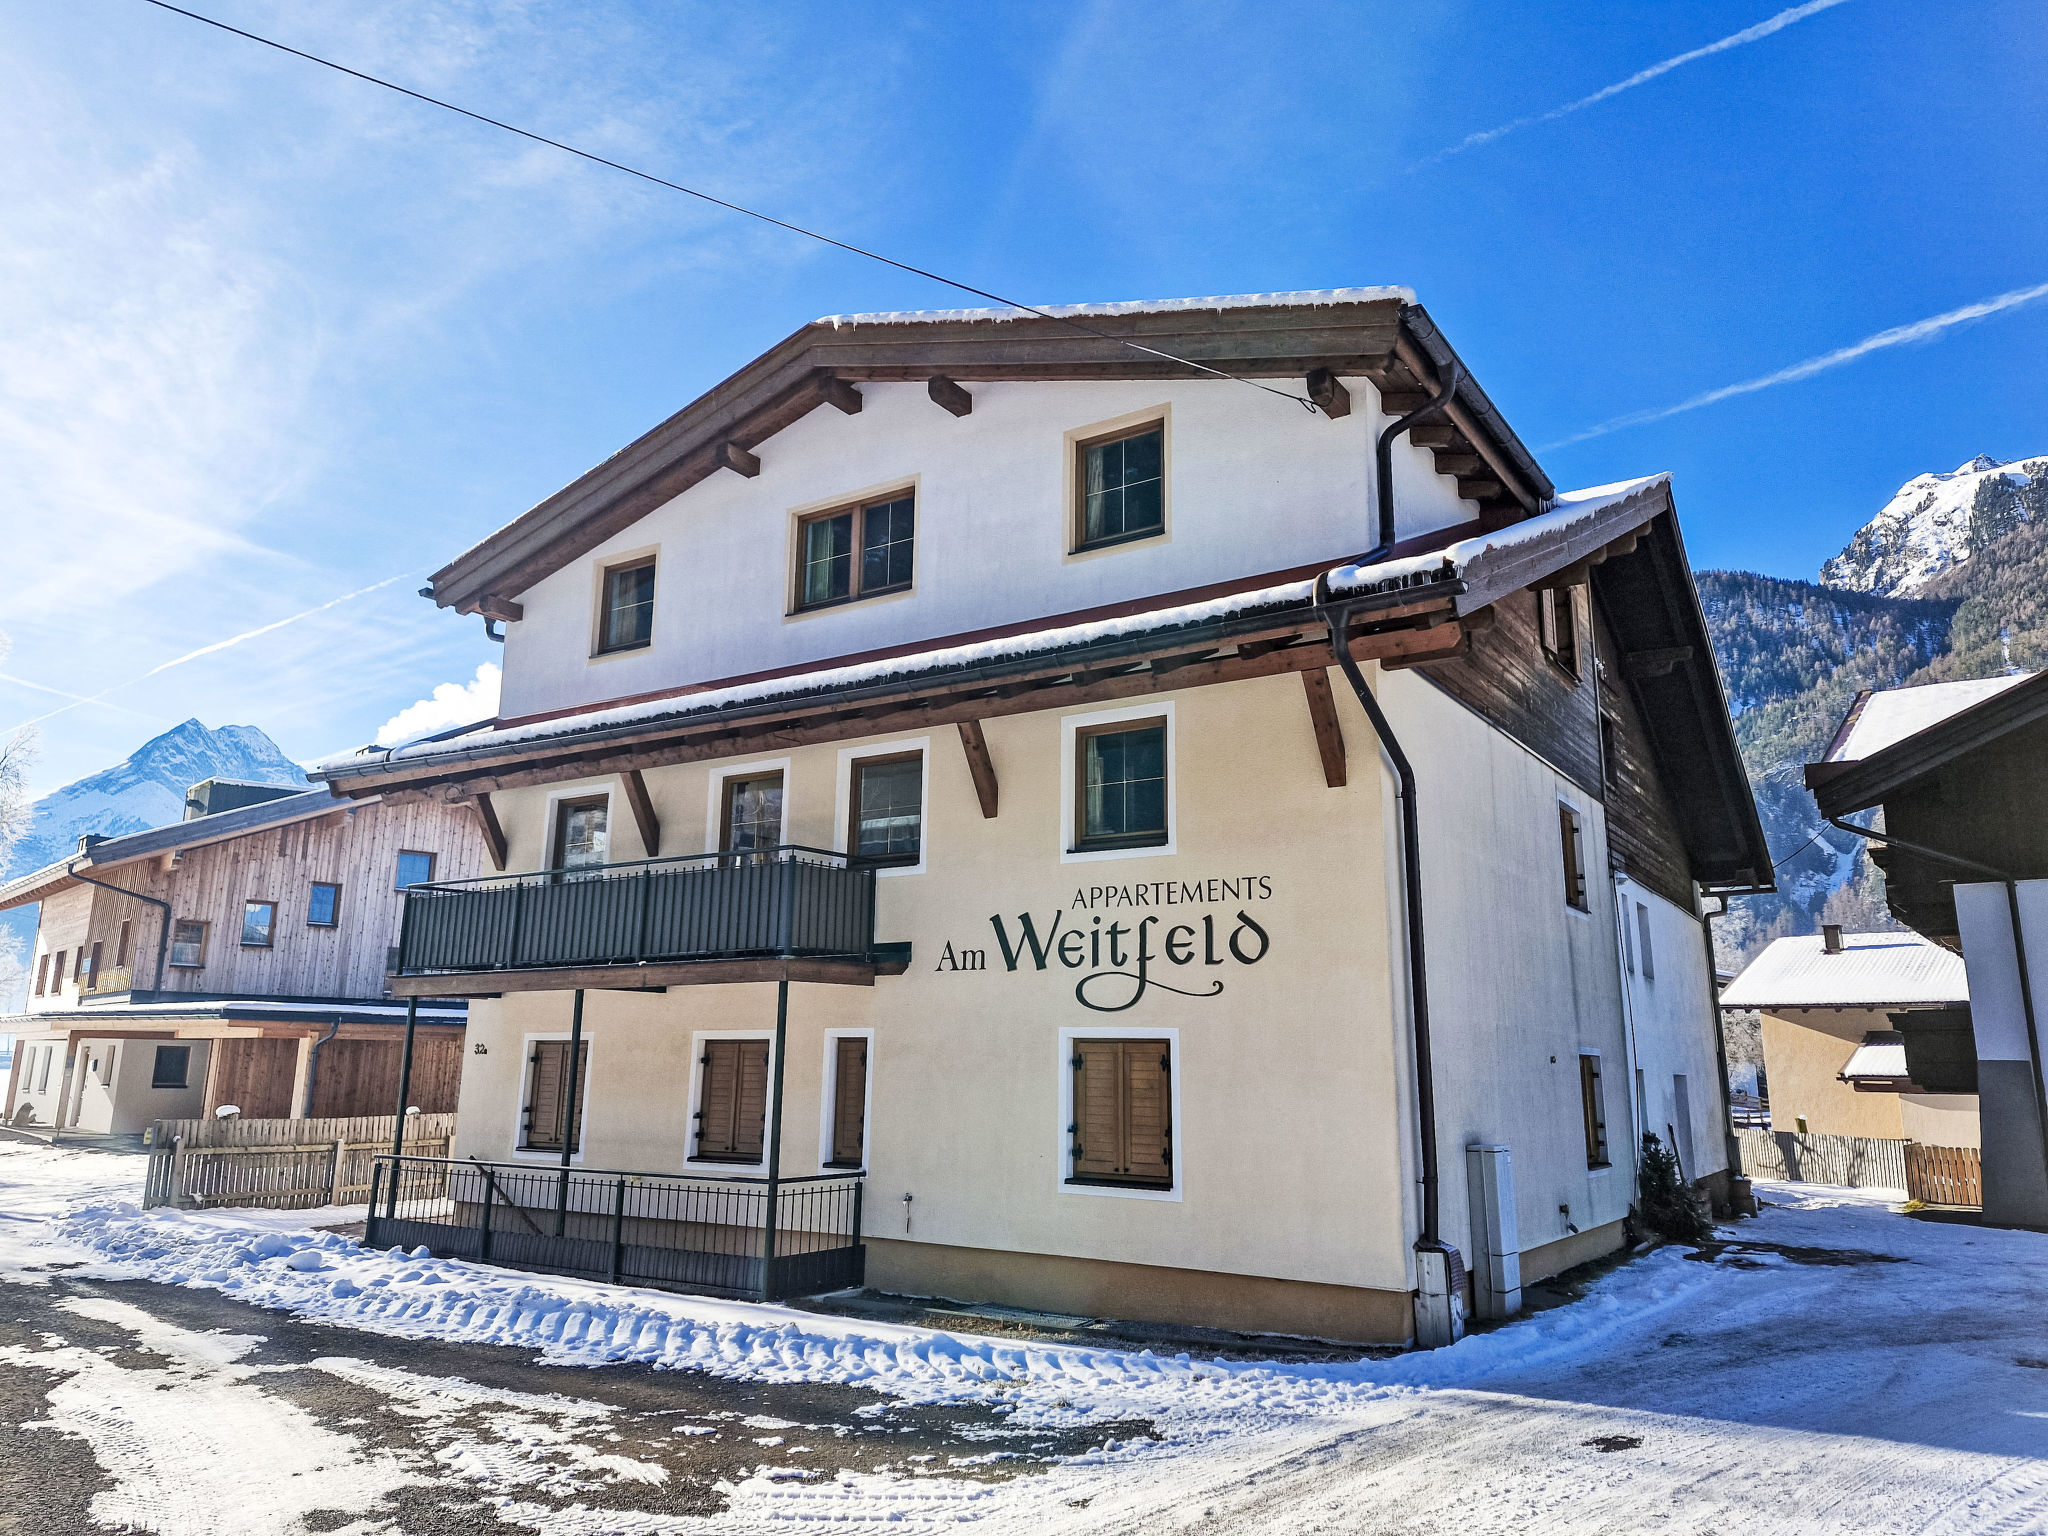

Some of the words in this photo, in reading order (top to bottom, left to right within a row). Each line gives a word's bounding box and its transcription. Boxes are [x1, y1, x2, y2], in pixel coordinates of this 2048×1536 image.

[1071, 875, 1272, 910] APPARTEMENTS
[934, 939, 987, 972] Am
[988, 909, 1271, 1013] Weitfeld
